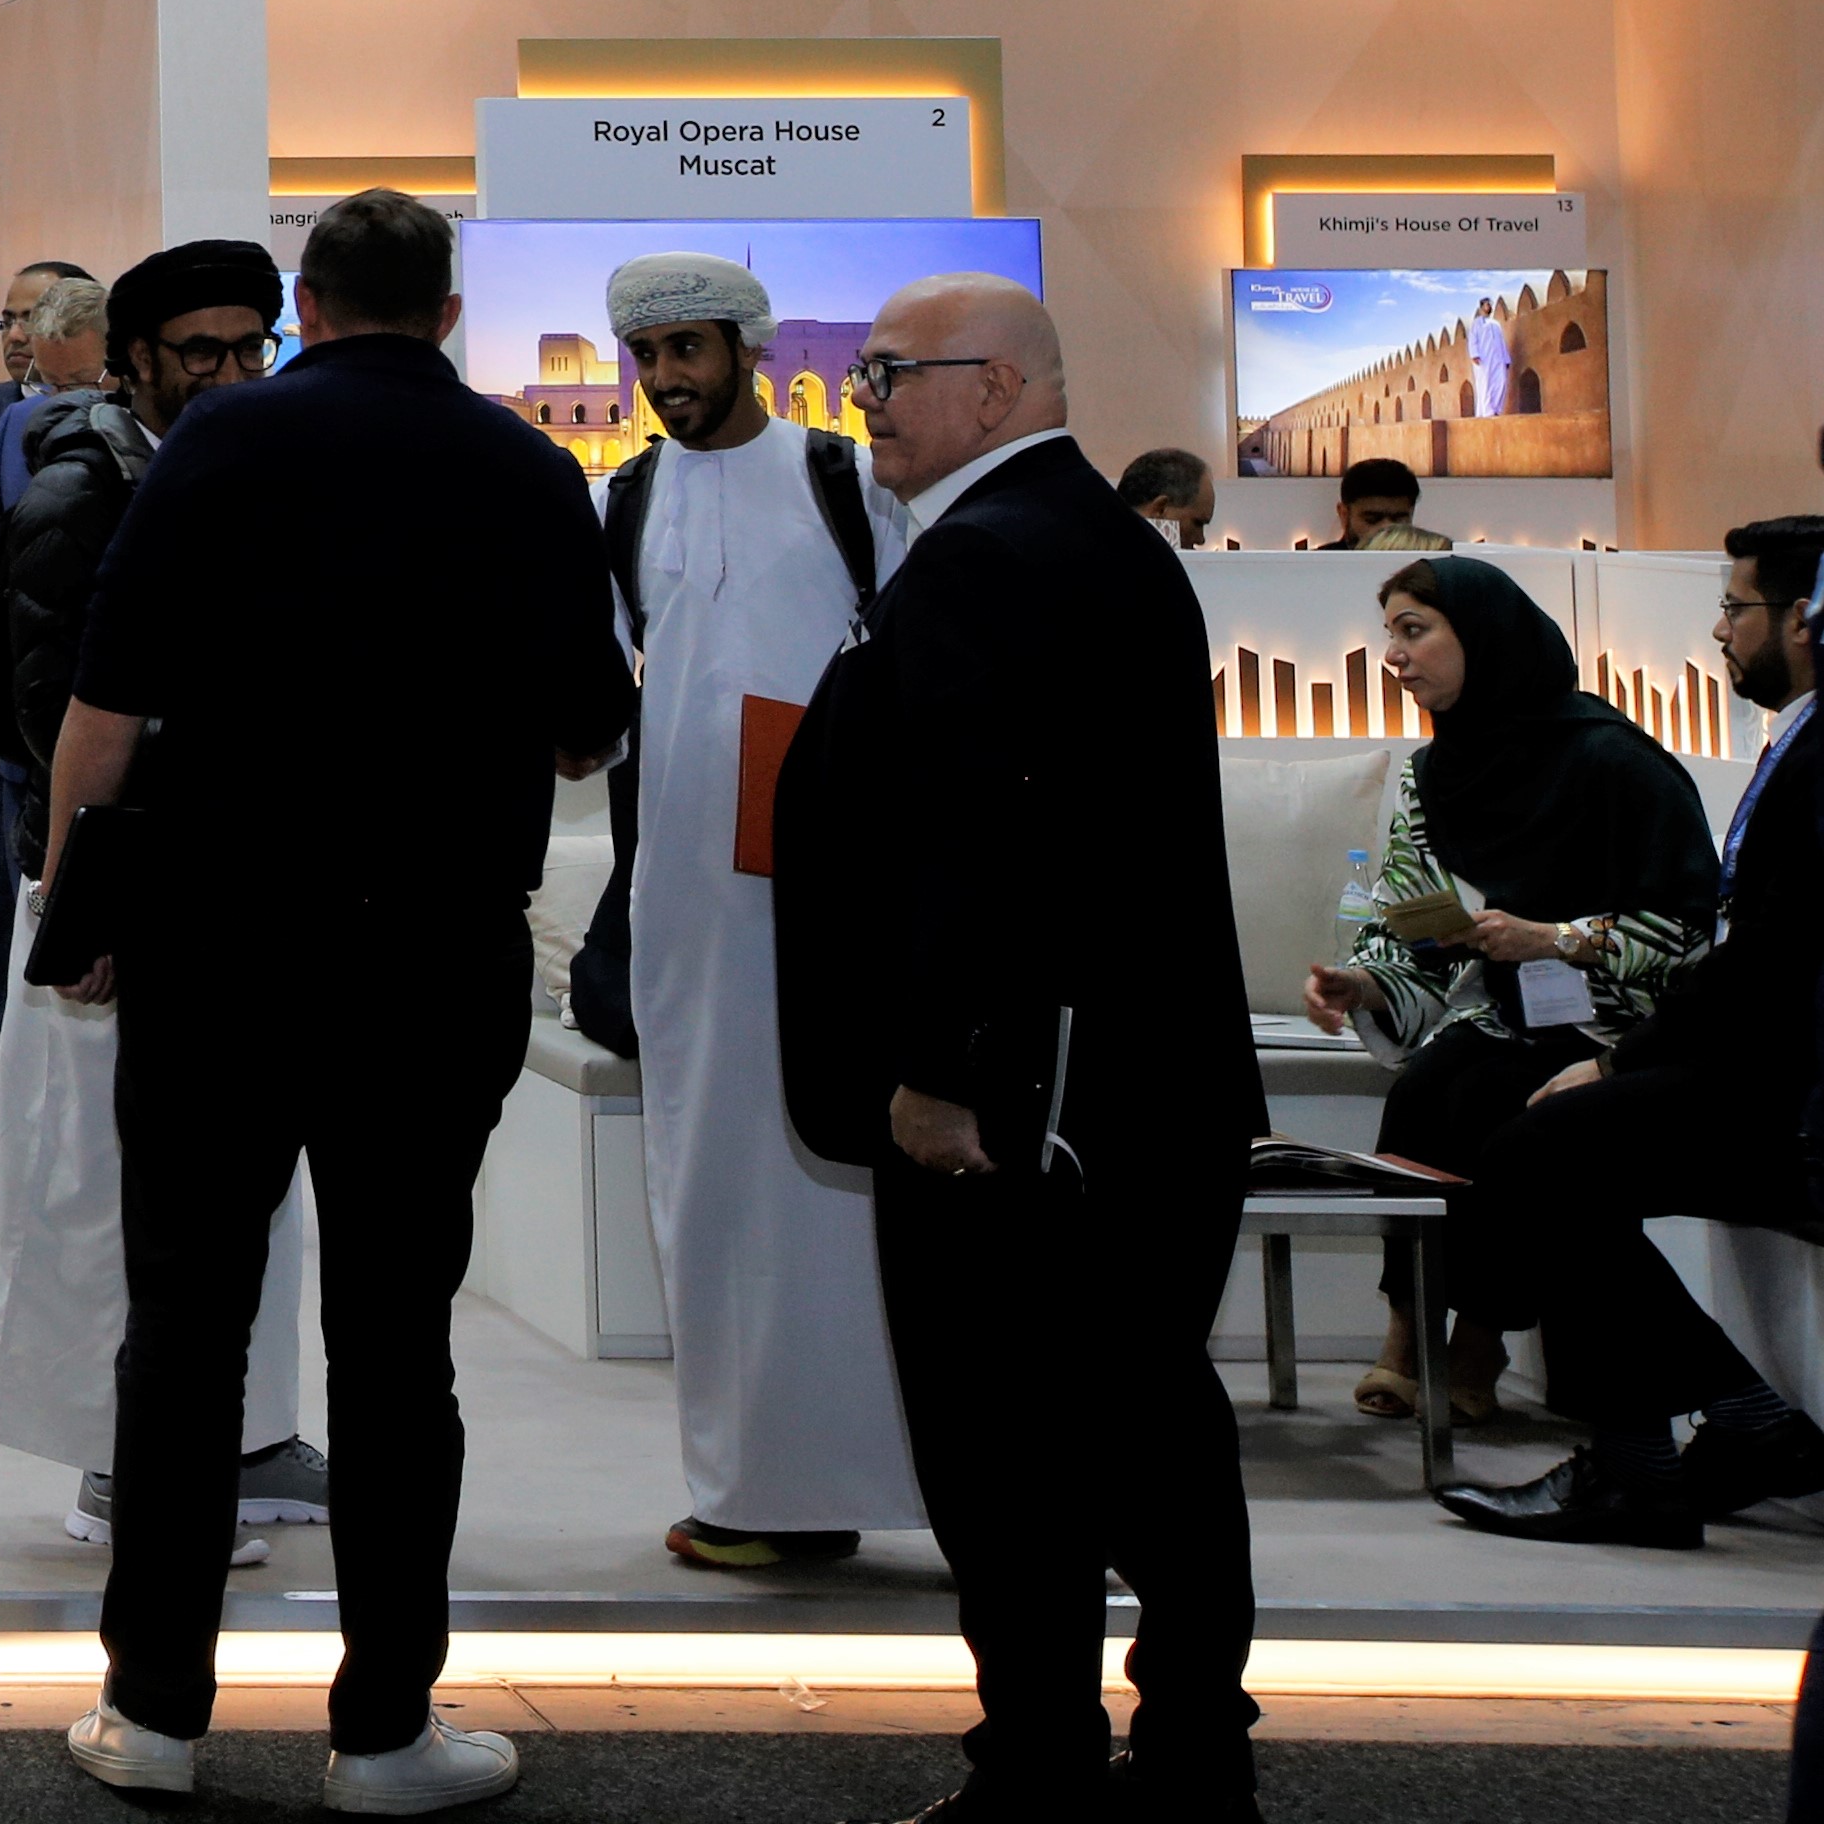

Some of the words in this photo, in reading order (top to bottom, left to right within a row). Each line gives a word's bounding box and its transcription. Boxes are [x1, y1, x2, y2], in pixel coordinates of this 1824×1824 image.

[931, 108, 946, 127] 2
[594, 119, 668, 146] Royal
[679, 120, 764, 146] Opera
[775, 120, 860, 142] House
[679, 154, 777, 176] Muscat
[1557, 199, 1574, 213] 13
[1319, 216, 1389, 234] Khimji's
[1395, 217, 1451, 232] House
[1457, 217, 1480, 232] Of
[1485, 217, 1539, 232] Travel
